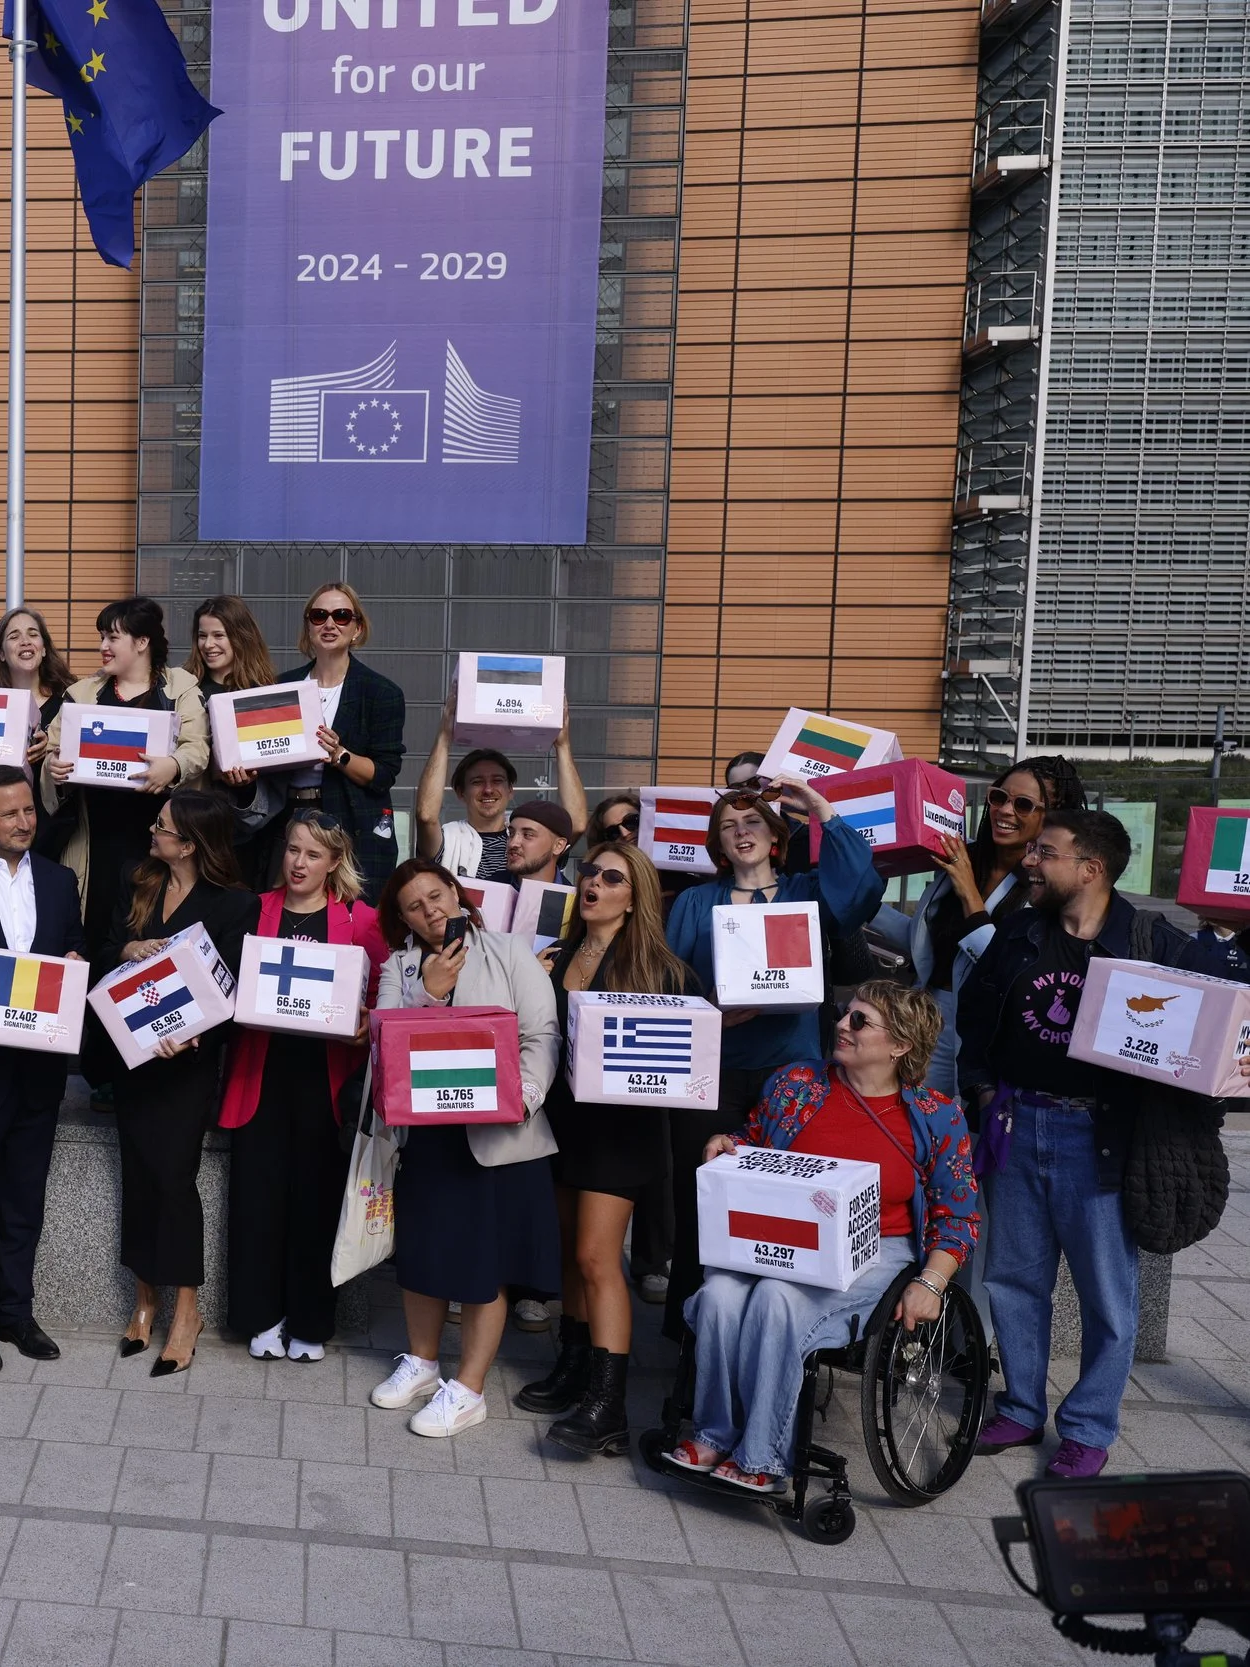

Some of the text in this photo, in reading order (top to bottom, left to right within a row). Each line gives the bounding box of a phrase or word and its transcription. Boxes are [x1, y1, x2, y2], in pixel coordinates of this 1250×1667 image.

[331, 54, 486, 94] for our
[280, 127, 533, 181] FUTURE
[297, 253, 383, 282] 2024
[419, 252, 507, 281] 2029
[496, 698, 523, 708] 4.894
[256, 737, 291, 751] 167.550
[260, 747, 289, 757] SIGNATURES
[96, 760, 127, 772] 59.508
[799, 766, 825, 778] SIGNATUR
[804, 759, 831, 774] 5.693
[96, 771, 126, 779] SIGNATURES
[924, 805, 963, 836] Luxembourg
[668, 844, 696, 856] 25.373
[668, 854, 695, 862] SIGNATURES
[753, 969, 786, 981] 4.278
[1032, 971, 1086, 991] MY VOI
[750, 982, 790, 990] SIGNATURES
[276, 996, 311, 1010] 66.565
[4, 1008, 38, 1023] 67.402
[276, 1007, 310, 1018] SIGNATURES
[3, 1020, 36, 1031] SIGNATURES
[150, 1010, 183, 1033] 65.963
[1022, 1009, 1072, 1044] MY CHO
[156, 1020, 187, 1038] SIGNATURES
[1124, 1036, 1159, 1056] 3.228
[1118, 1048, 1160, 1066] SIGNATURES
[627, 1073, 668, 1086] 43.214
[436, 1088, 474, 1101] 16.765
[627, 1086, 667, 1095] SIGNATURES
[436, 1102, 475, 1110] SIGNATURES
[750, 1151, 783, 1159] FOR
[783, 1155, 827, 1165] SAFE
[759, 1166, 791, 1175] THE
[849, 1195, 862, 1218] FOR
[860, 1183, 876, 1209] SAFE
[753, 1243, 796, 1261] 43.297
[852, 1253, 860, 1272] IN
[860, 1243, 872, 1266] THE
[754, 1256, 795, 1270] SIGNATURES
